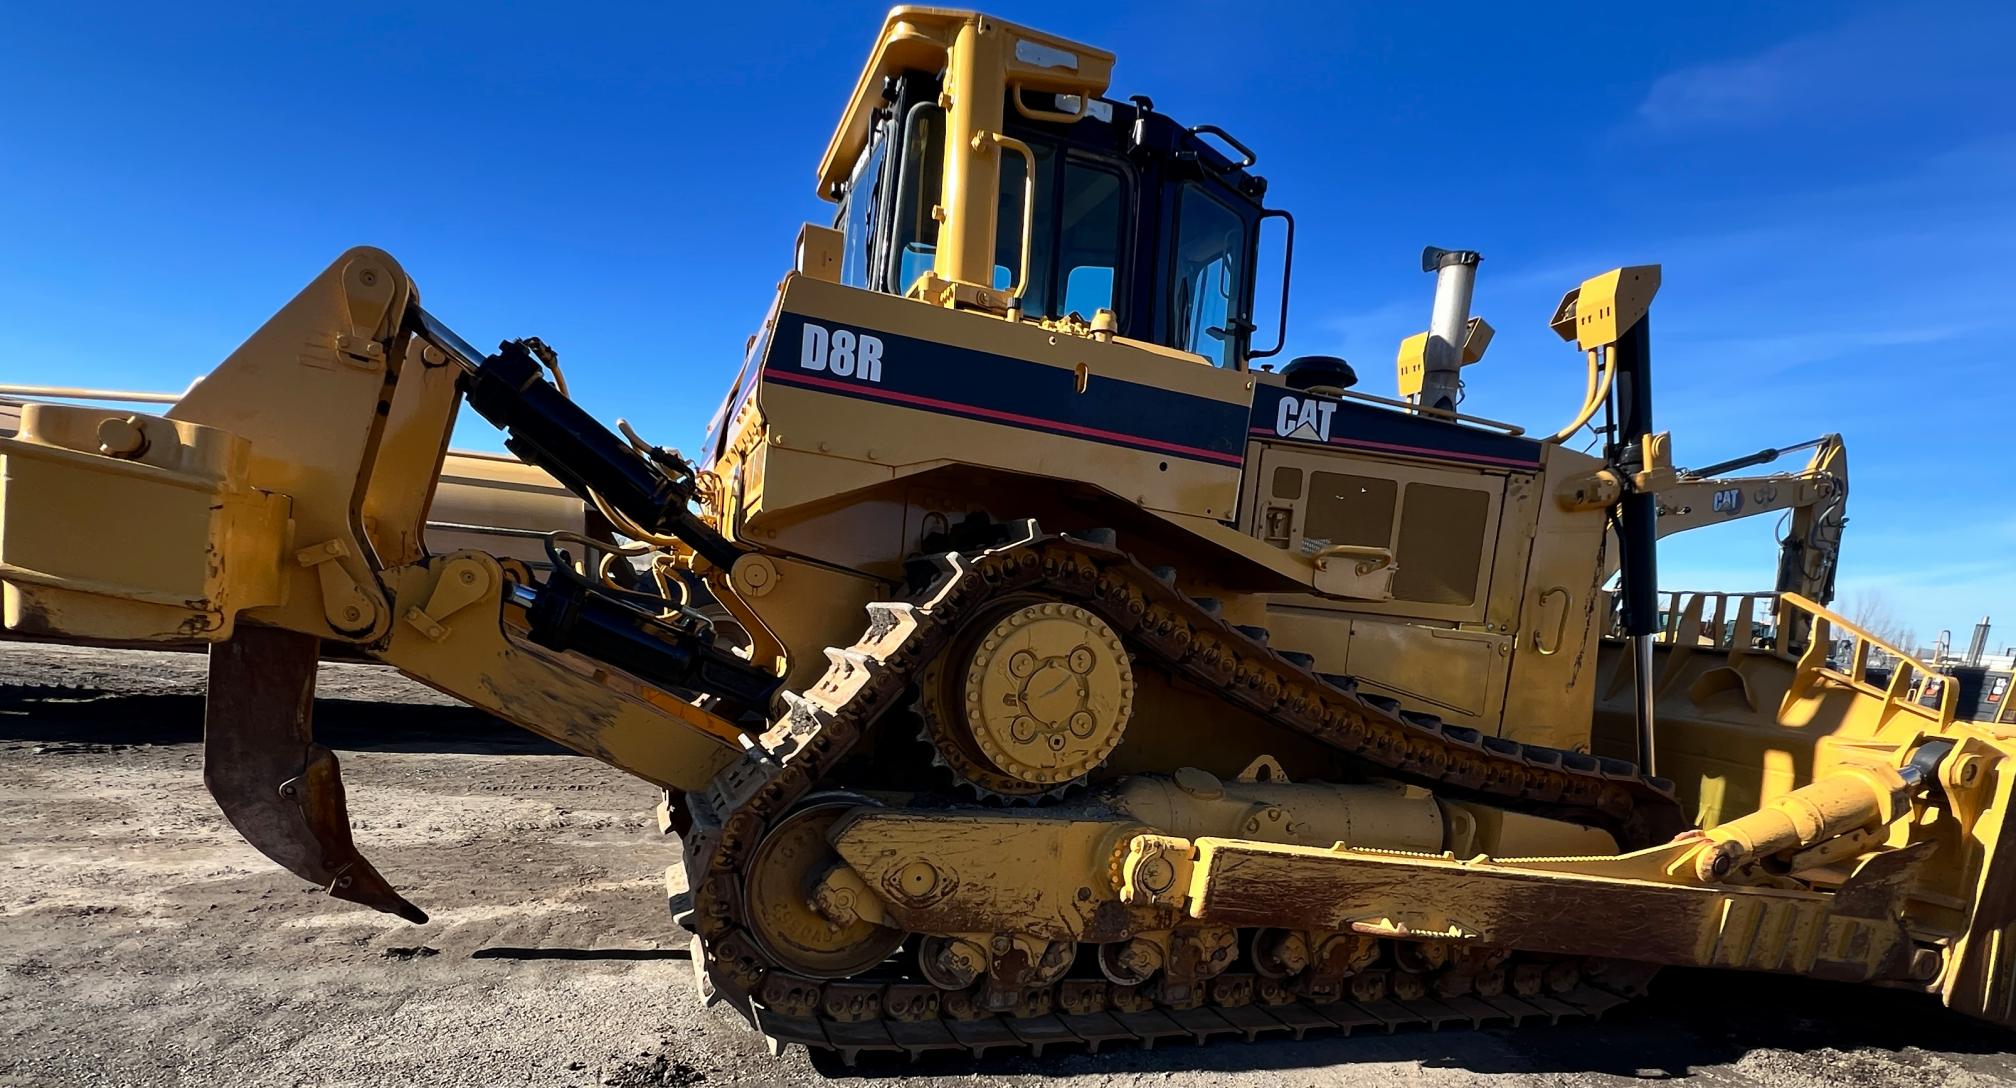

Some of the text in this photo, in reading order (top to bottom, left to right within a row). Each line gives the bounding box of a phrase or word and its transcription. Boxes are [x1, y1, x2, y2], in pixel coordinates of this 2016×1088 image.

[801, 323, 883, 382] D8R
[1277, 396, 1337, 442] CAT
[1713, 489, 1739, 511] CAT
